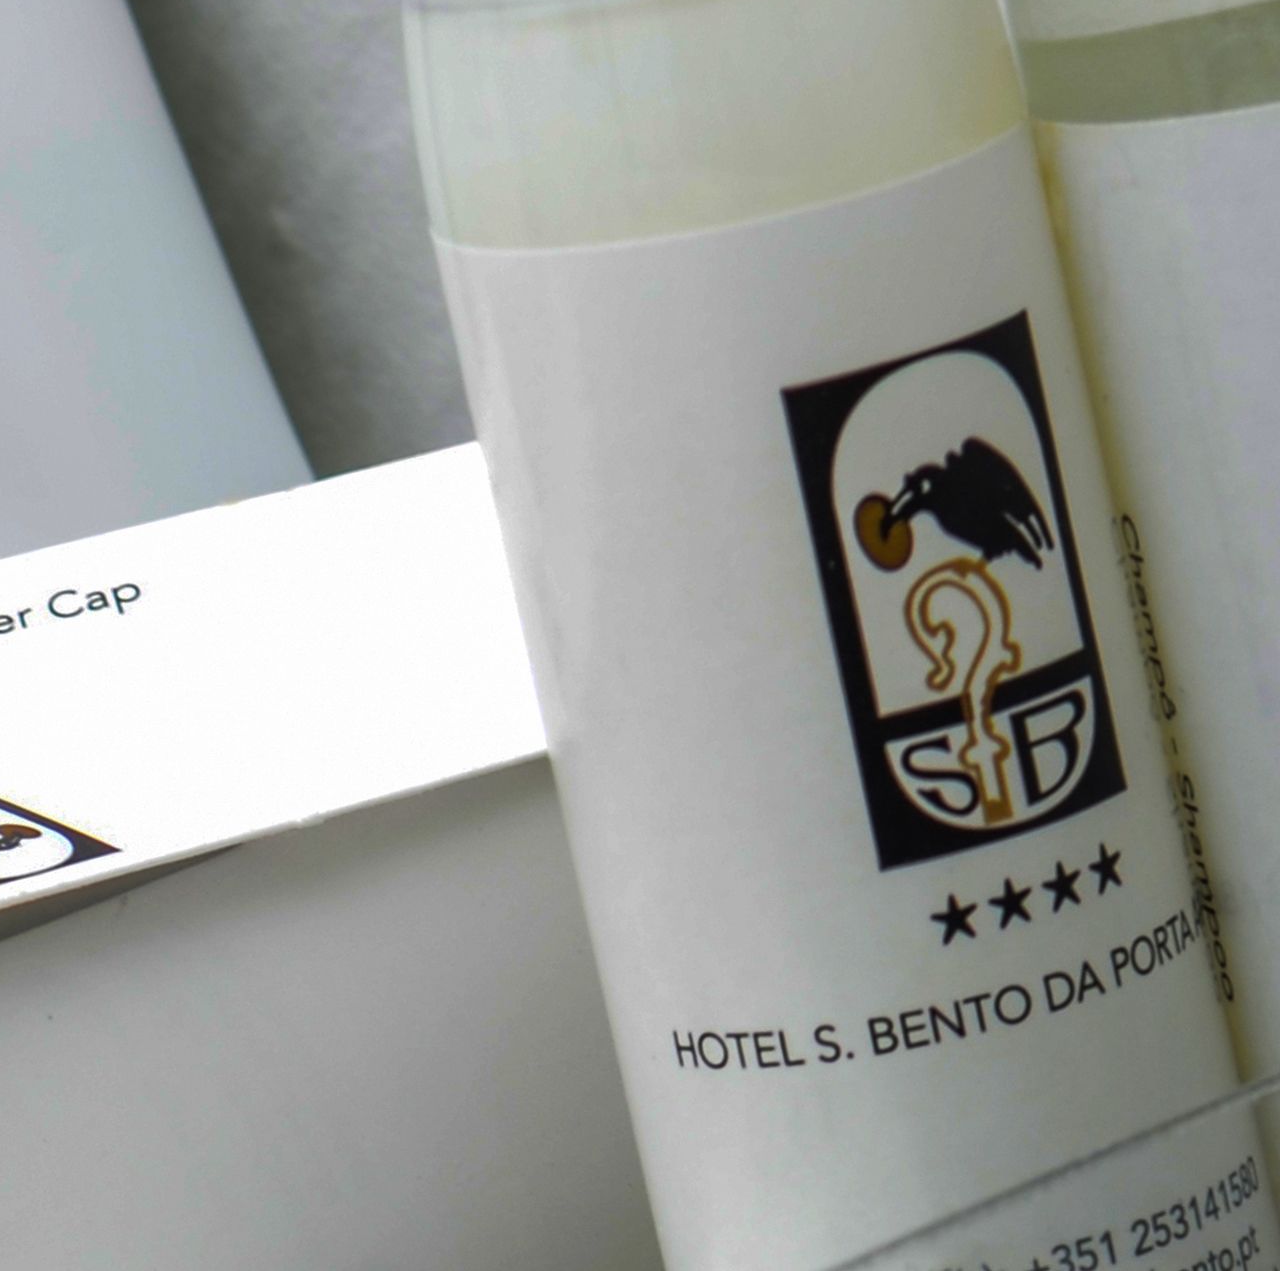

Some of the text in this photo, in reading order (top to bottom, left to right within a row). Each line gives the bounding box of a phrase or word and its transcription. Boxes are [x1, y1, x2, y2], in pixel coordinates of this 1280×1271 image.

[46, 580, 143, 621] Cap
[1177, 773, 1235, 1003] Shampoo
[673, 1030, 806, 1069] HOTEL
[814, 1024, 854, 1063] S.
[868, 984, 1032, 1055] BENTO
[1043, 961, 1106, 1013] DA
[1110, 908, 1196, 988] PORTA
[1130, 1155, 1260, 1257] 253141580
